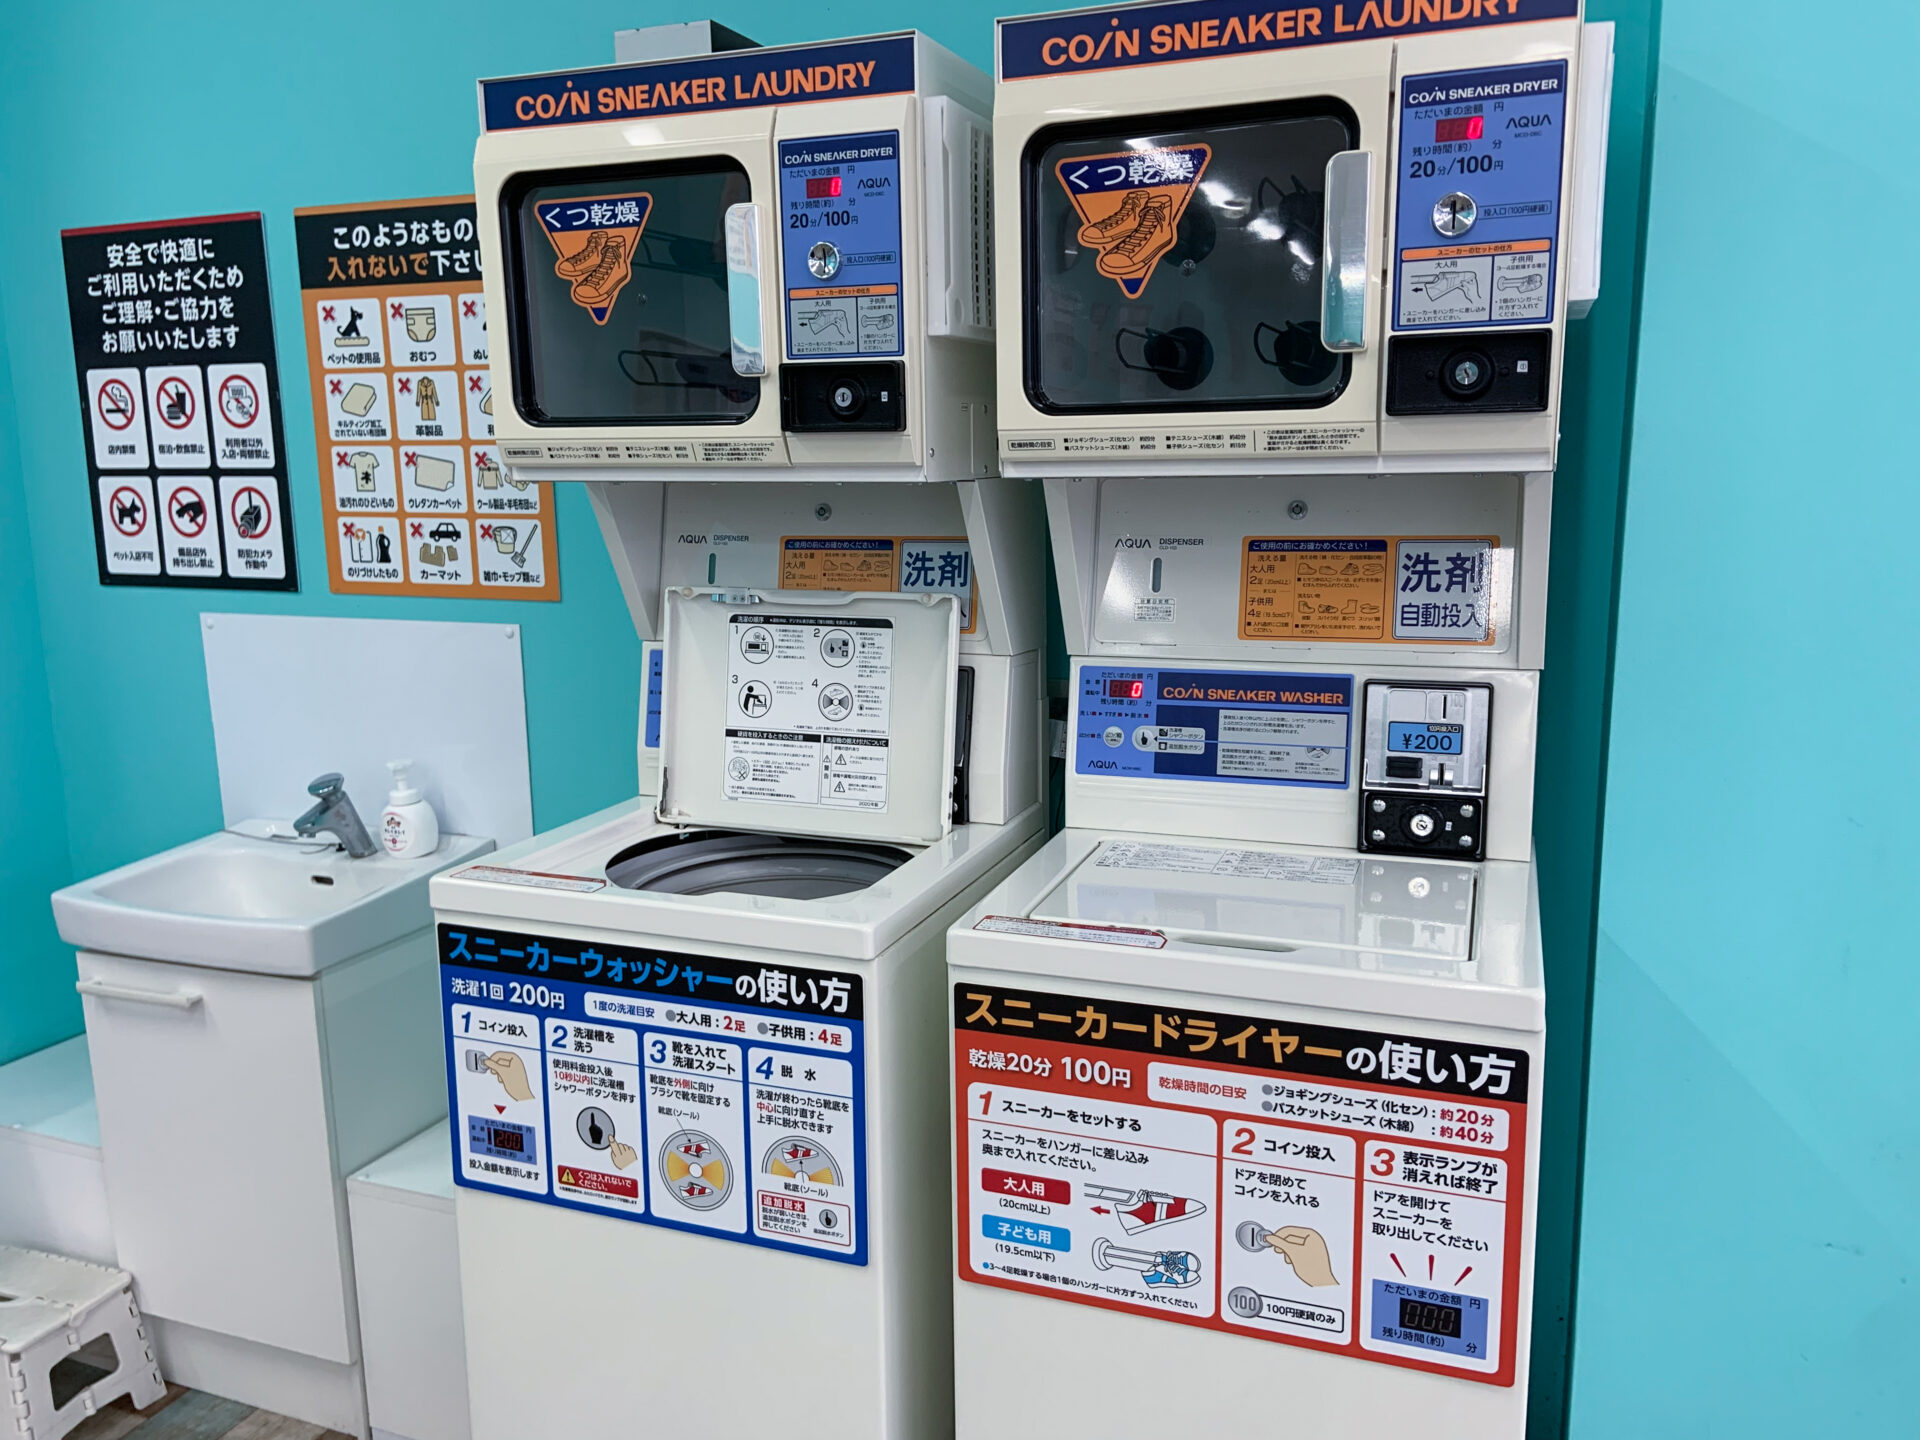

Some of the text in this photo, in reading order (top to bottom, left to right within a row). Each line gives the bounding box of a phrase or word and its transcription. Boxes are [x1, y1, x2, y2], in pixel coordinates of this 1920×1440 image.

[1150, 7, 1322, 54] SNEAKER
[598, 77, 726, 114] SNEAKER
[734, 61, 876, 100] LAUNDRY
[1449, 84, 1510, 99] SNEAKER
[1512, 79, 1558, 93] DRYER
[1414, 102, 1504, 120] ただいまの金額 円
[1506, 114, 1551, 129] AQUA
[1492, 139, 1502, 149] 分
[814, 150, 859, 162] SNEAKER
[860, 147, 893, 158] DRYER
[847, 165, 855, 174] 円
[1409, 155, 1504, 179] 20分/100円
[857, 177, 891, 189] AQUA
[849, 198, 856, 206] 分
[545, 201, 640, 228] くつ乾燥
[790, 211, 859, 229] 20分/100円
[106, 238, 214, 268] 安全で快適に
[1510, 255, 1533, 263] 子供用
[1435, 261, 1457, 269] 大人用
[87, 265, 244, 297] ご利用いただくため
[102, 296, 234, 324] ご理解・ご協力を
[102, 325, 239, 354] お願いいたします
[327, 352, 380, 364] ペットの使用品
[409, 351, 437, 362] おむつ
[416, 425, 443, 436] 革製品
[225, 438, 263, 449] 利用者以外
[340, 498, 395, 508] 油汚れのひどいもの
[409, 498, 462, 509] ウレタンカーペット
[678, 534, 708, 544] AQUA
[1115, 538, 1151, 549] AQUA
[1159, 538, 1204, 546] DISPENSER
[348, 567, 399, 579] のりづけしたもの
[421, 570, 461, 580] カーマット
[786, 561, 806, 569] 大人用
[904, 551, 970, 588] 洗剤
[1250, 565, 1274, 573] 大人用
[1400, 552, 1484, 593] 洗剤
[484, 571, 540, 582] 雑巾・モップ類など
[1248, 597, 1273, 606] 子供用
[1400, 602, 1482, 628] 自動投入
[813, 629, 821, 638] 2
[732, 675, 739, 684] 3
[811, 679, 819, 688] 4
[1131, 681, 1143, 698] 0
[1207, 688, 1276, 702] SNEAKER
[1279, 691, 1343, 704] WASHER
[1402, 733, 1452, 751] ¥200
[1088, 760, 1118, 770] AQUA
[448, 930, 851, 1013] スニーカーウォッシャーの使い方
[451, 977, 566, 1010] 洗濯1回 200円
[593, 1000, 655, 1018] 1度の洗濯目安
[461, 1011, 472, 1034] 1
[479, 1020, 528, 1038] コイン投入
[552, 1025, 568, 1049] 2
[573, 1026, 615, 1044] 洗濯槽を
[965, 992, 1516, 1095] スニーカードライヤーの使い方
[574, 1040, 593, 1054] 洗う
[650, 1040, 667, 1064] 3
[672, 1041, 727, 1060] 靴を入れて
[553, 1058, 614, 1077] 使用料金投入後
[673, 1055, 736, 1075] 洗濯スタート
[756, 1056, 774, 1080] 4
[968, 1048, 1132, 1089] 乾燥20分 100円
[554, 1070, 625, 1091] 10秒以内に洗濯槽
[649, 1073, 715, 1093] 靴底を外側に向け
[1158, 1077, 1247, 1098] 乾燥時間の目安
[554, 1081, 636, 1104] シャワーボタンを押す
[650, 1085, 731, 1108] ブラシで靴を固定する
[756, 1089, 850, 1112] 洗濯が終わったら靴底を
[658, 1106, 700, 1121] 靴底(ソール)
[756, 1102, 825, 1121] 中心に向け直すと
[978, 1091, 992, 1116] 1
[756, 1113, 834, 1134] 上手に脱水できます
[1002, 1099, 1141, 1131] スニーカーをセットする
[982, 1129, 1149, 1165] スニーカーをハンガーに差し込み
[1231, 1127, 1256, 1156] 2
[1264, 1140, 1335, 1162] コイン投入
[982, 1144, 1097, 1172] 奥まで入れてください。
[1370, 1148, 1395, 1176] 3
[1403, 1151, 1497, 1177] 表示ランプが
[469, 1159, 540, 1181] 投入金額を表示します
[578, 1171, 632, 1188] くつは入れないで
[1234, 1168, 1307, 1190] ドアを閉めて
[1402, 1166, 1498, 1194] 消えれば終了
[578, 1178, 609, 1192] ください。
[784, 1182, 829, 1198] 靴底(ソール)
[1003, 1178, 1044, 1197] 大人用
[763, 1195, 804, 1213] 追加脱水
[999, 1198, 1050, 1216] (20cm以上)
[1234, 1185, 1320, 1209] コインを入れる
[1373, 1190, 1450, 1213] ドアを開けて
[1373, 1206, 1452, 1230] スニーカーを
[997, 1223, 1051, 1245] 子ども用
[1372, 1222, 1489, 1252] 取り出してください
[995, 1243, 1056, 1263] (19.5cm以下)
[1233, 1293, 1256, 1311] 100
[1384, 1282, 1481, 1309] ただいまの金額 円
[1266, 1303, 1335, 1325] 100円硬貨のみ
[1382, 1326, 1477, 1353] 残り時間(約) 分
